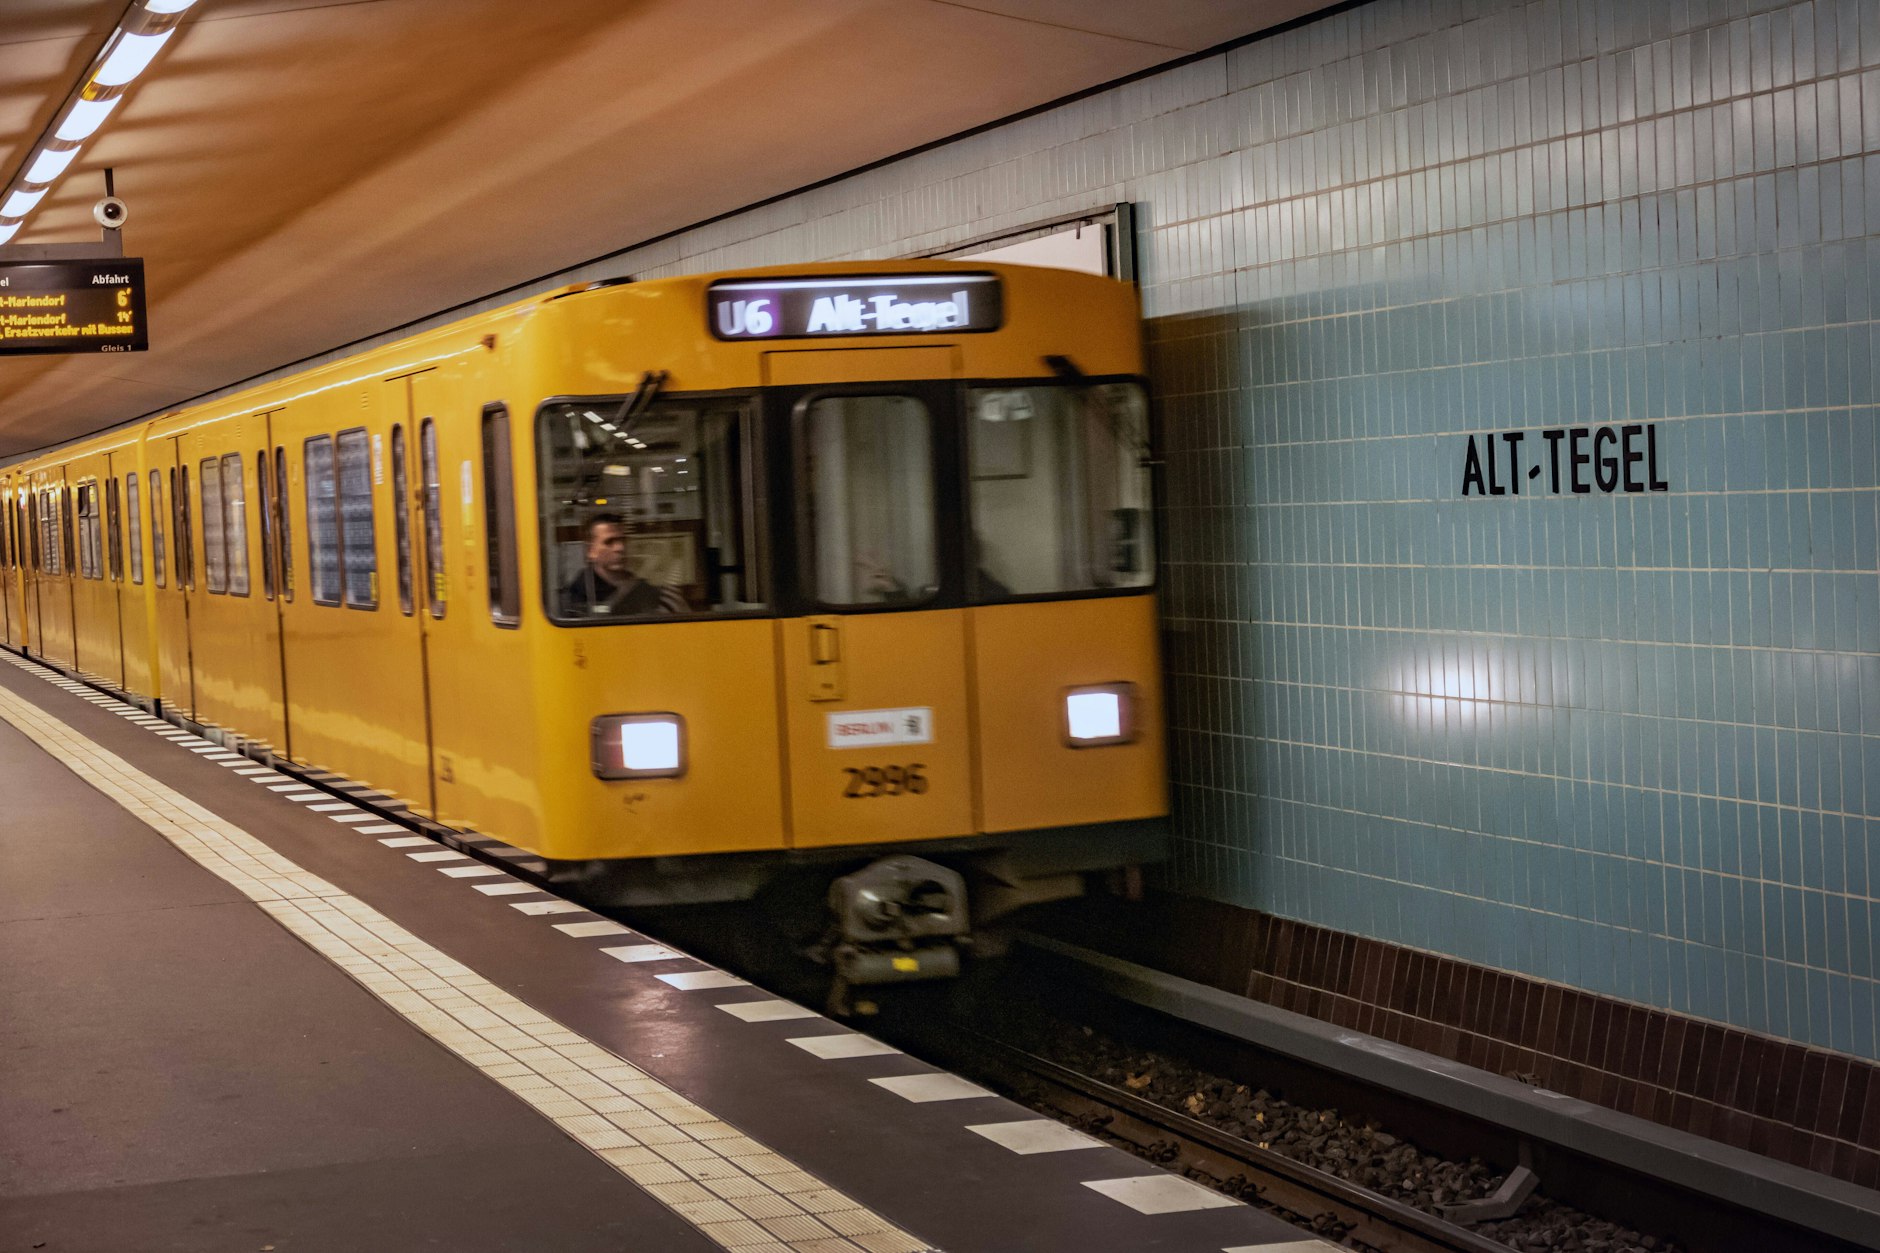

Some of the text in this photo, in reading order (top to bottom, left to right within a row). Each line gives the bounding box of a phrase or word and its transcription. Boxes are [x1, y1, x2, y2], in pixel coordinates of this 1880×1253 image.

[92, 274, 129, 284] Abfahrt
[717, 290, 969, 335] U6 Alt-Tegel
[4, 325, 80, 338] Ersatzverkehr
[101, 344, 124, 352] Gleis
[1462, 424, 1668, 495] ALT-TEGEL
[843, 763, 929, 799] 2996
